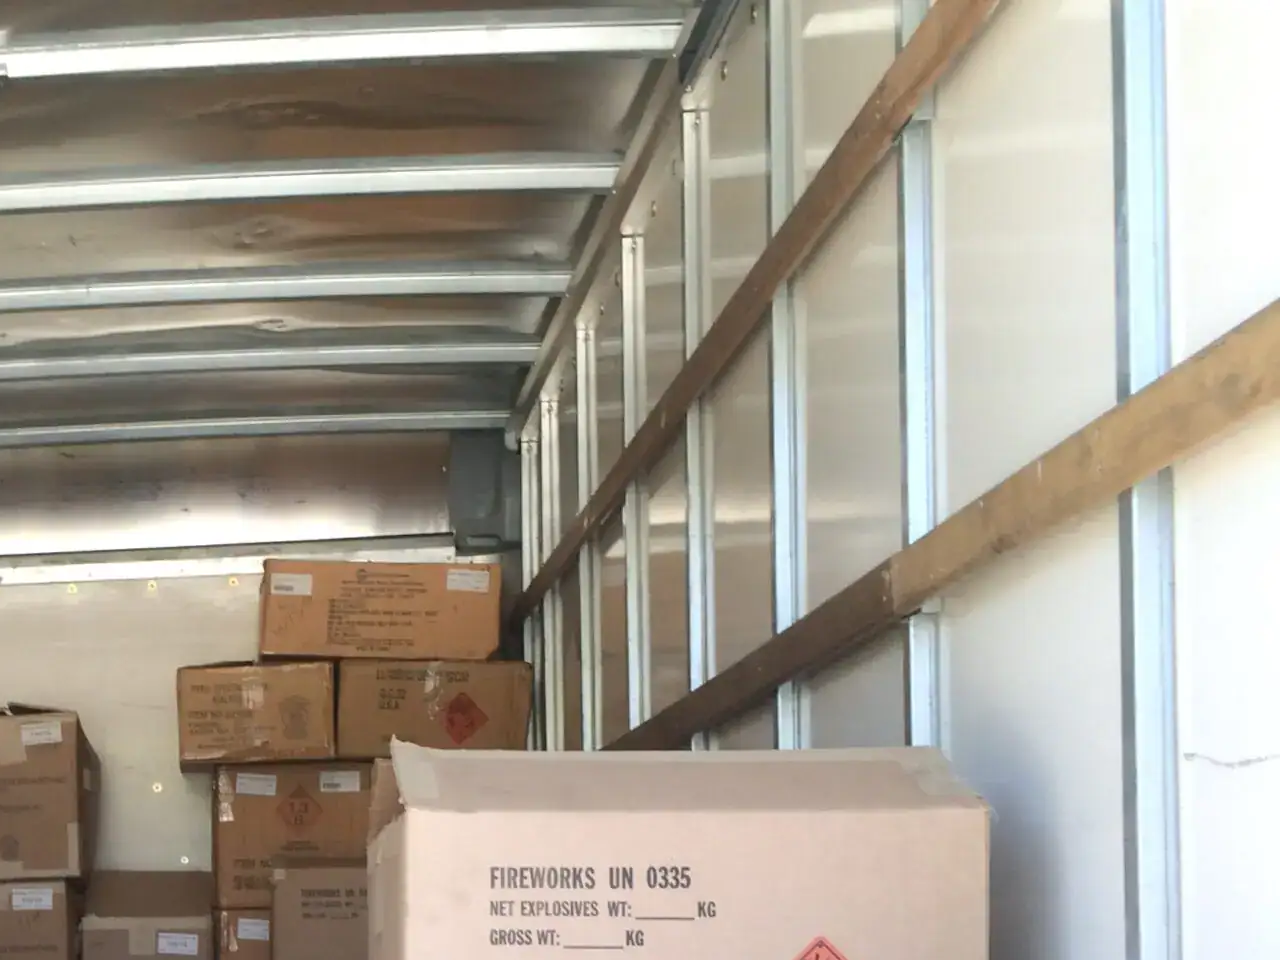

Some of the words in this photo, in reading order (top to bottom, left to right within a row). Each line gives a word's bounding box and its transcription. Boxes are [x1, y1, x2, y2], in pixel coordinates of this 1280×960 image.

[489, 866, 596, 890] FIREWORKS
[608, 866, 634, 890] UN
[645, 866, 692, 890] 0335
[489, 900, 515, 918] NET
[519, 900, 600, 918] EXPLOSIVES
[607, 901, 632, 919] WT:
[697, 901, 717, 919] KG
[489, 929, 533, 946] GROSS
[536, 929, 561, 946] WT:
[625, 930, 645, 947] KG
